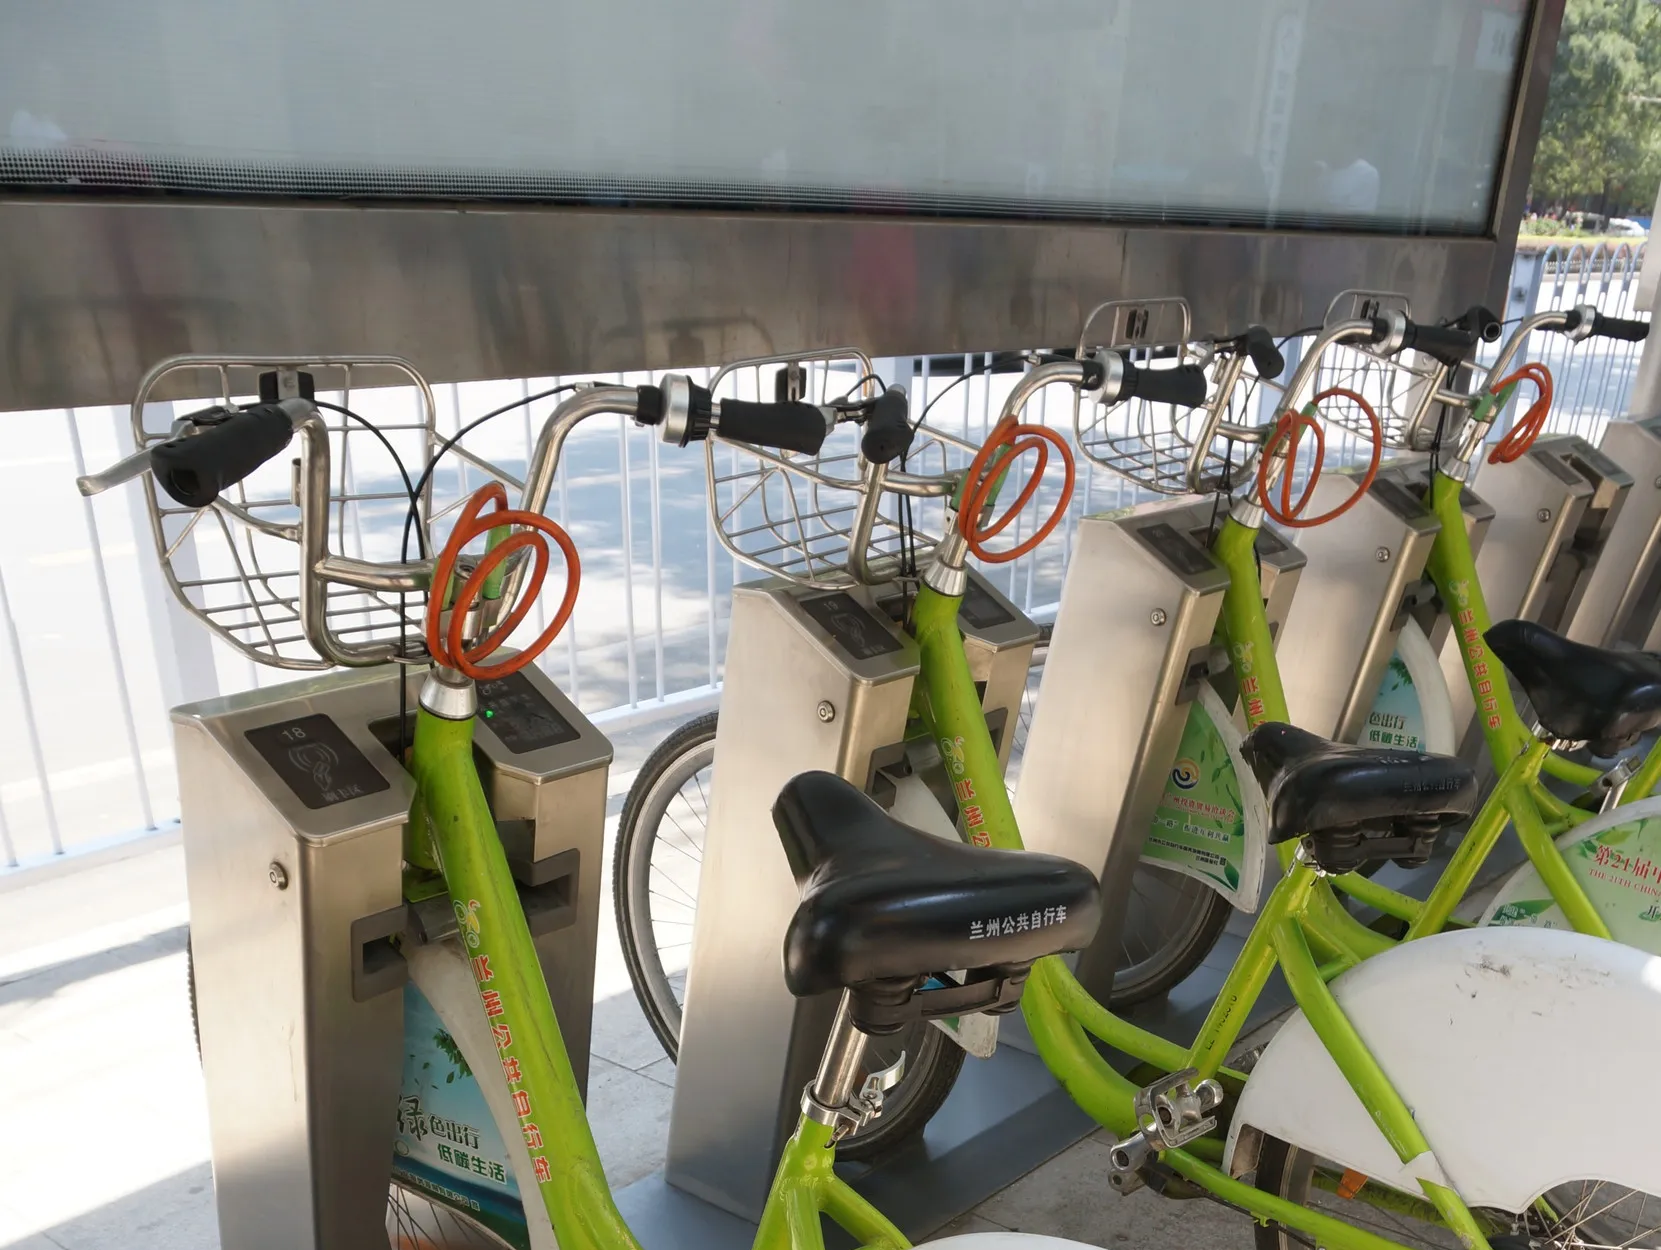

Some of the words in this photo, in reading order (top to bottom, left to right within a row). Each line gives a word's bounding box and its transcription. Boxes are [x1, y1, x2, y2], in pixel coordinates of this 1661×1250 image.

[1458, 608, 1502, 730] 兰州公共自行车
[282, 726, 306, 741] 18
[1369, 729, 1418, 750] 低碳生活
[969, 904, 1067, 940] 兰州公共自行车
[471, 954, 552, 1184] 兰州公共自行车
[437, 1143, 506, 1183] 低碳生活
